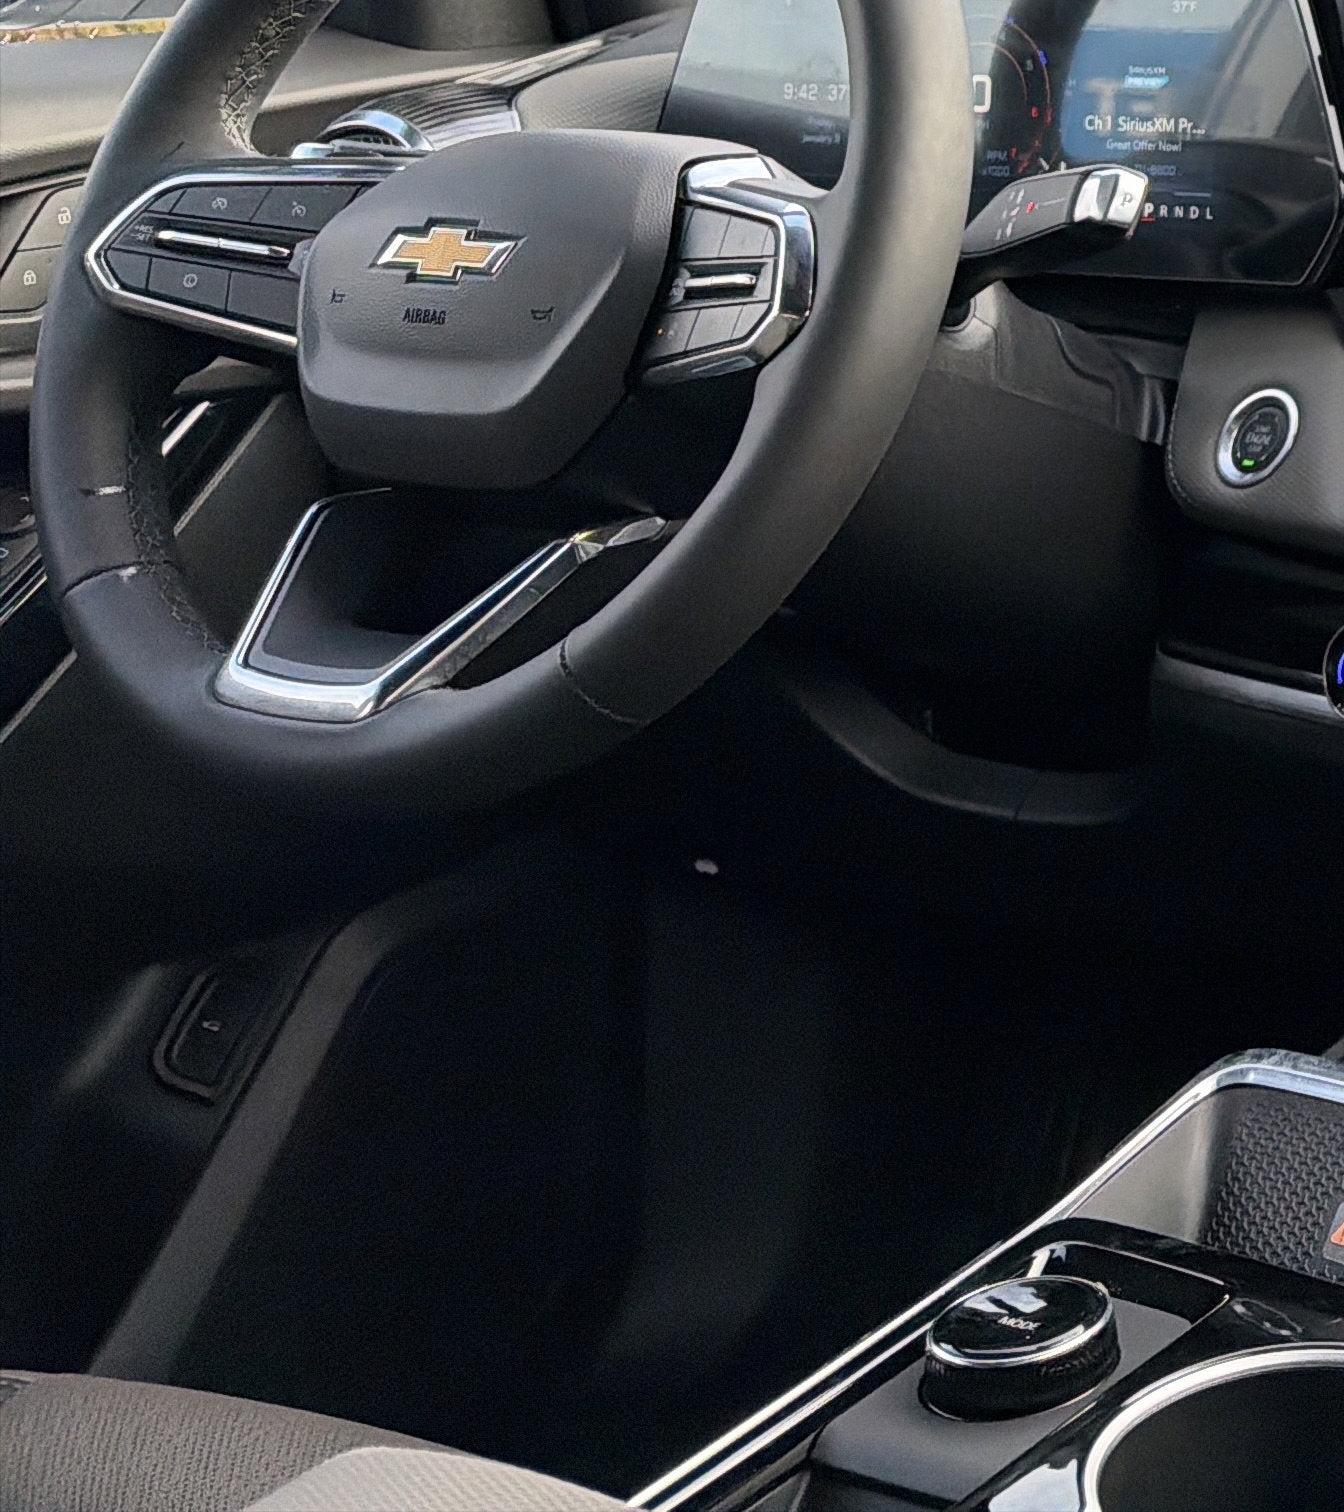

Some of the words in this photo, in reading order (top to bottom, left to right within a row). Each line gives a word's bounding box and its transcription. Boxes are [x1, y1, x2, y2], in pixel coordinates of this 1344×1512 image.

[783, 82, 818, 101] 9:42
[1085, 115, 1102, 130] Ch
[1117, 116, 1174, 133] SiriusXM
[1106, 140, 1131, 150] Great
[1133, 140, 1155, 151] Offer
[1158, 140, 1182, 152] Now!
[1121, 193, 1133, 208] P
[1145, 203, 1154, 216] P
[1159, 203, 1168, 217] R
[1175, 205, 1184, 219] N
[1190, 206, 1199, 219] D
[1205, 207, 1213, 219] L
[402, 307, 447, 325] AIRBAG
